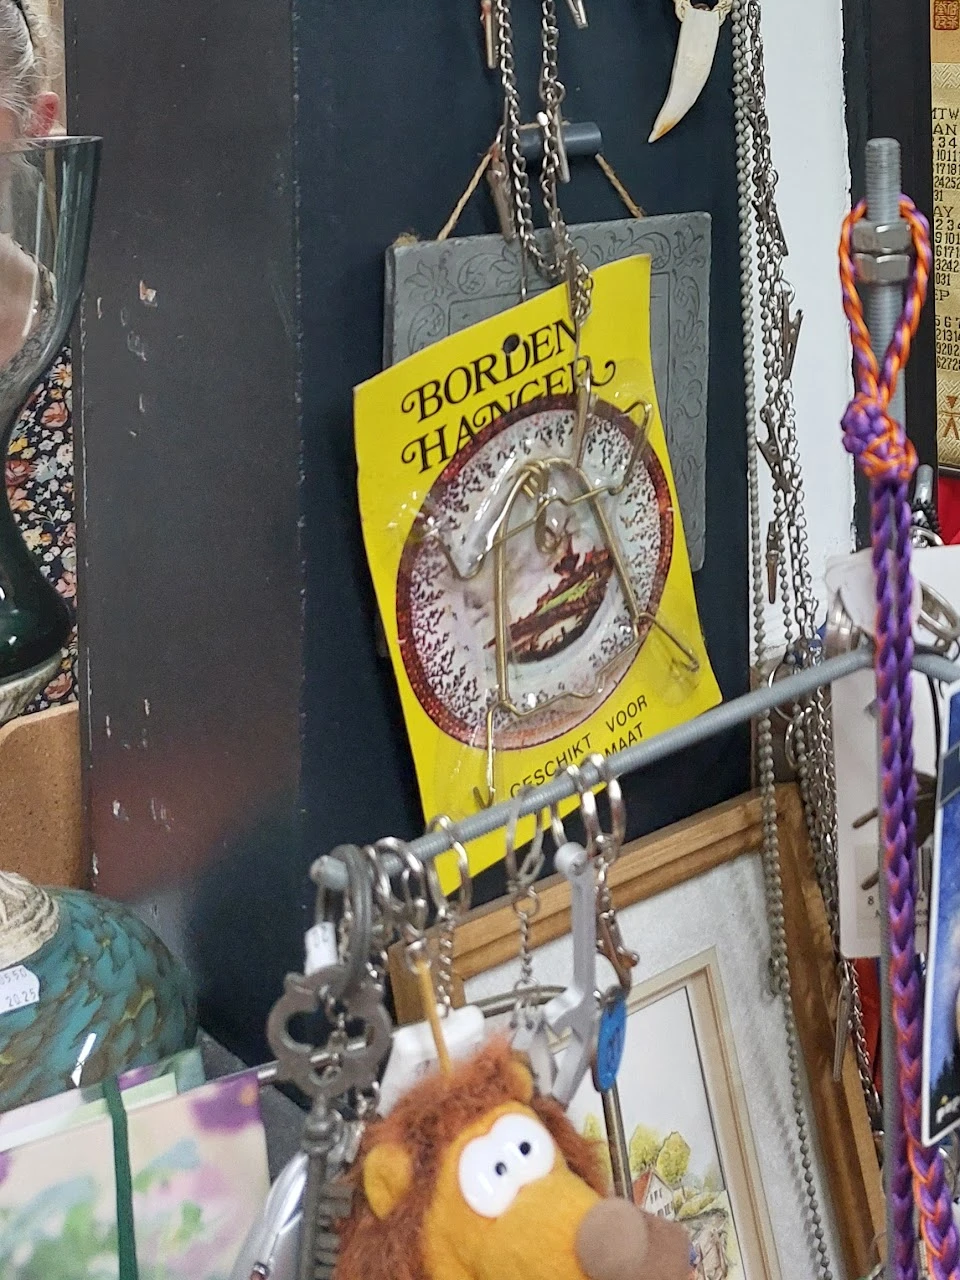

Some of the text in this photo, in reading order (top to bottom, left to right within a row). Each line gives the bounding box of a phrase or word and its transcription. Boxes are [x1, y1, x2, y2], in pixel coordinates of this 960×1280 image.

[932, 123, 957, 136] AN
[933, 205, 955, 218] AY
[401, 319, 578, 423] BORDEN
[510, 695, 648, 798] GSCHIKT VOOR
